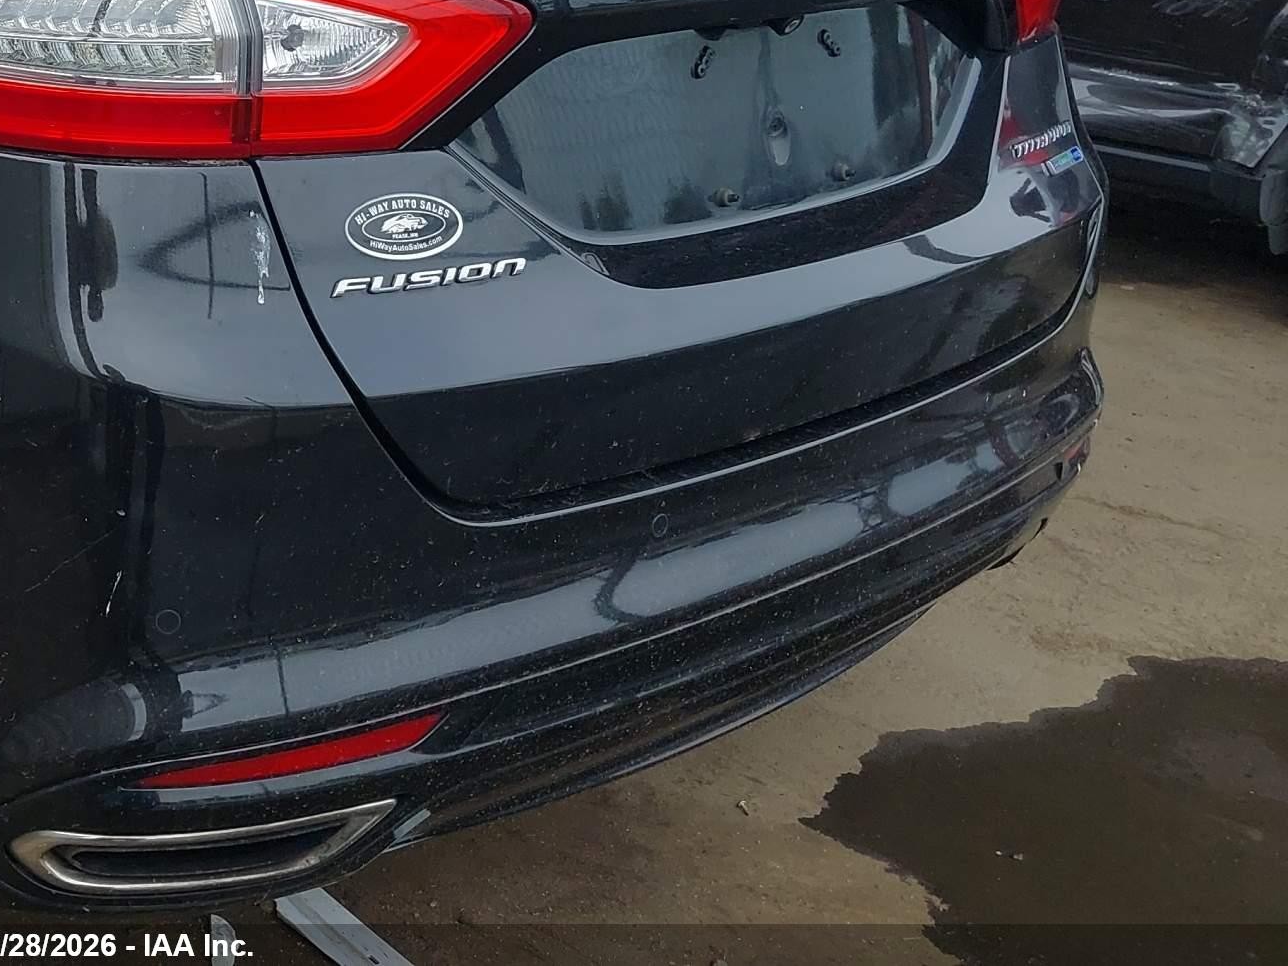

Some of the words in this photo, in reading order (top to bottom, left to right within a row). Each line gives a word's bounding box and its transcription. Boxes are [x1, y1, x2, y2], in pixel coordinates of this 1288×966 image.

[354, 201, 389, 225] HI-WAY
[392, 199, 417, 210] AUTO
[420, 200, 450, 219] SALES
[369, 236, 443, 252] HiWayAutoSales.com
[330, 257, 527, 298] FUSION
